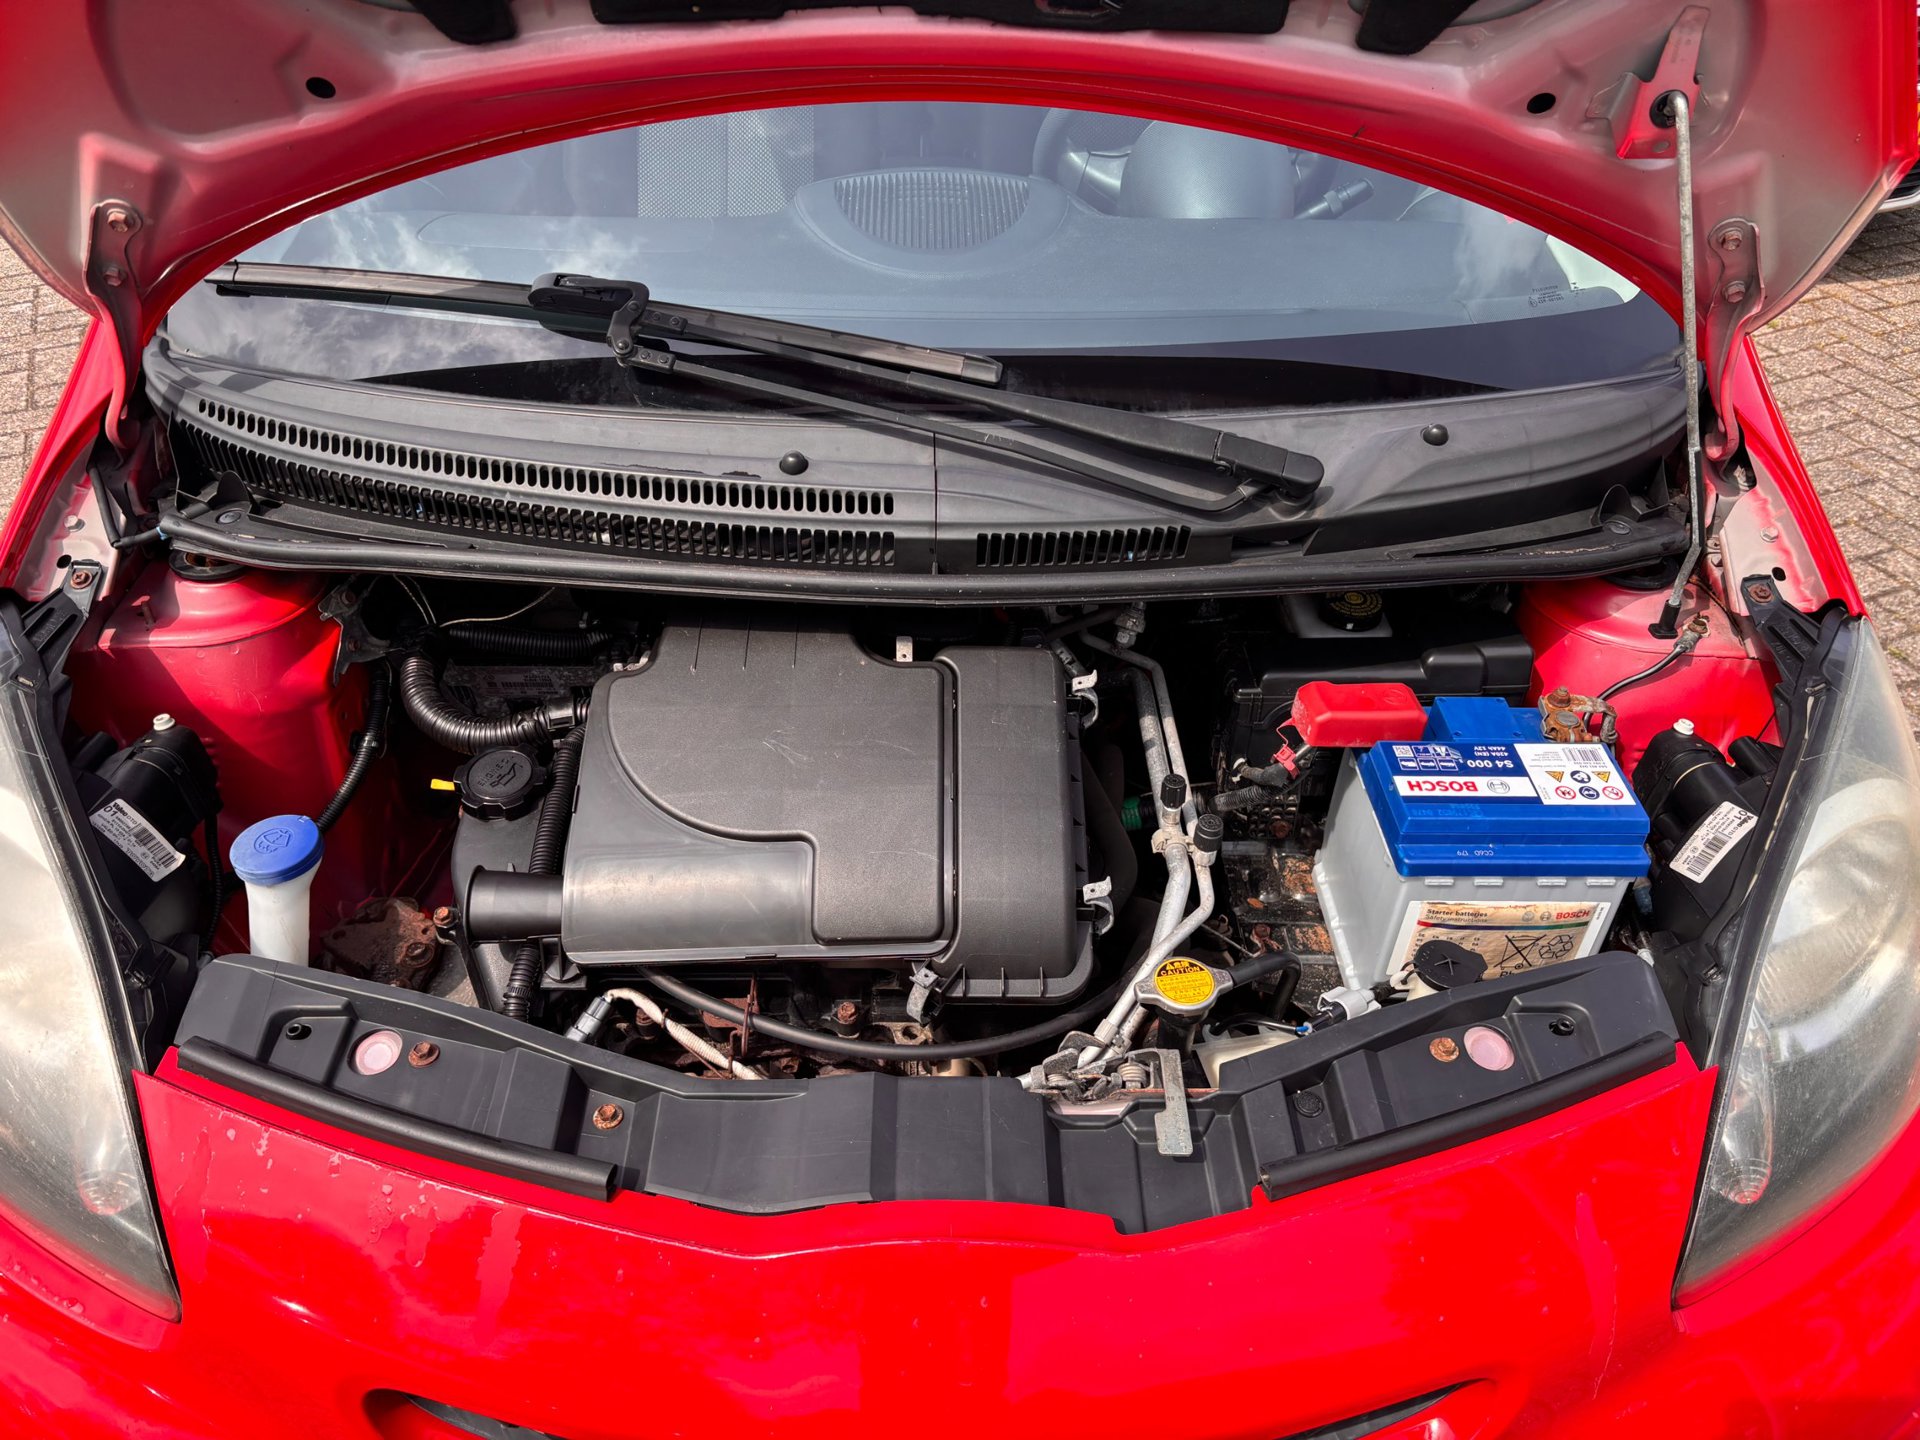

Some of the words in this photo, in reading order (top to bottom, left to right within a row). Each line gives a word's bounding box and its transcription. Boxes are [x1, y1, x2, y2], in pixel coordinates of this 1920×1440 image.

[1466, 759, 1492, 768] 000
[1495, 760, 1514, 768] S4
[1407, 780, 1478, 792] BOSCH
[103, 805, 118, 817] 01
[1455, 910, 1488, 918] batteries
[1555, 910, 1590, 920] BOSCH
[1161, 967, 1200, 976] CAUTION
